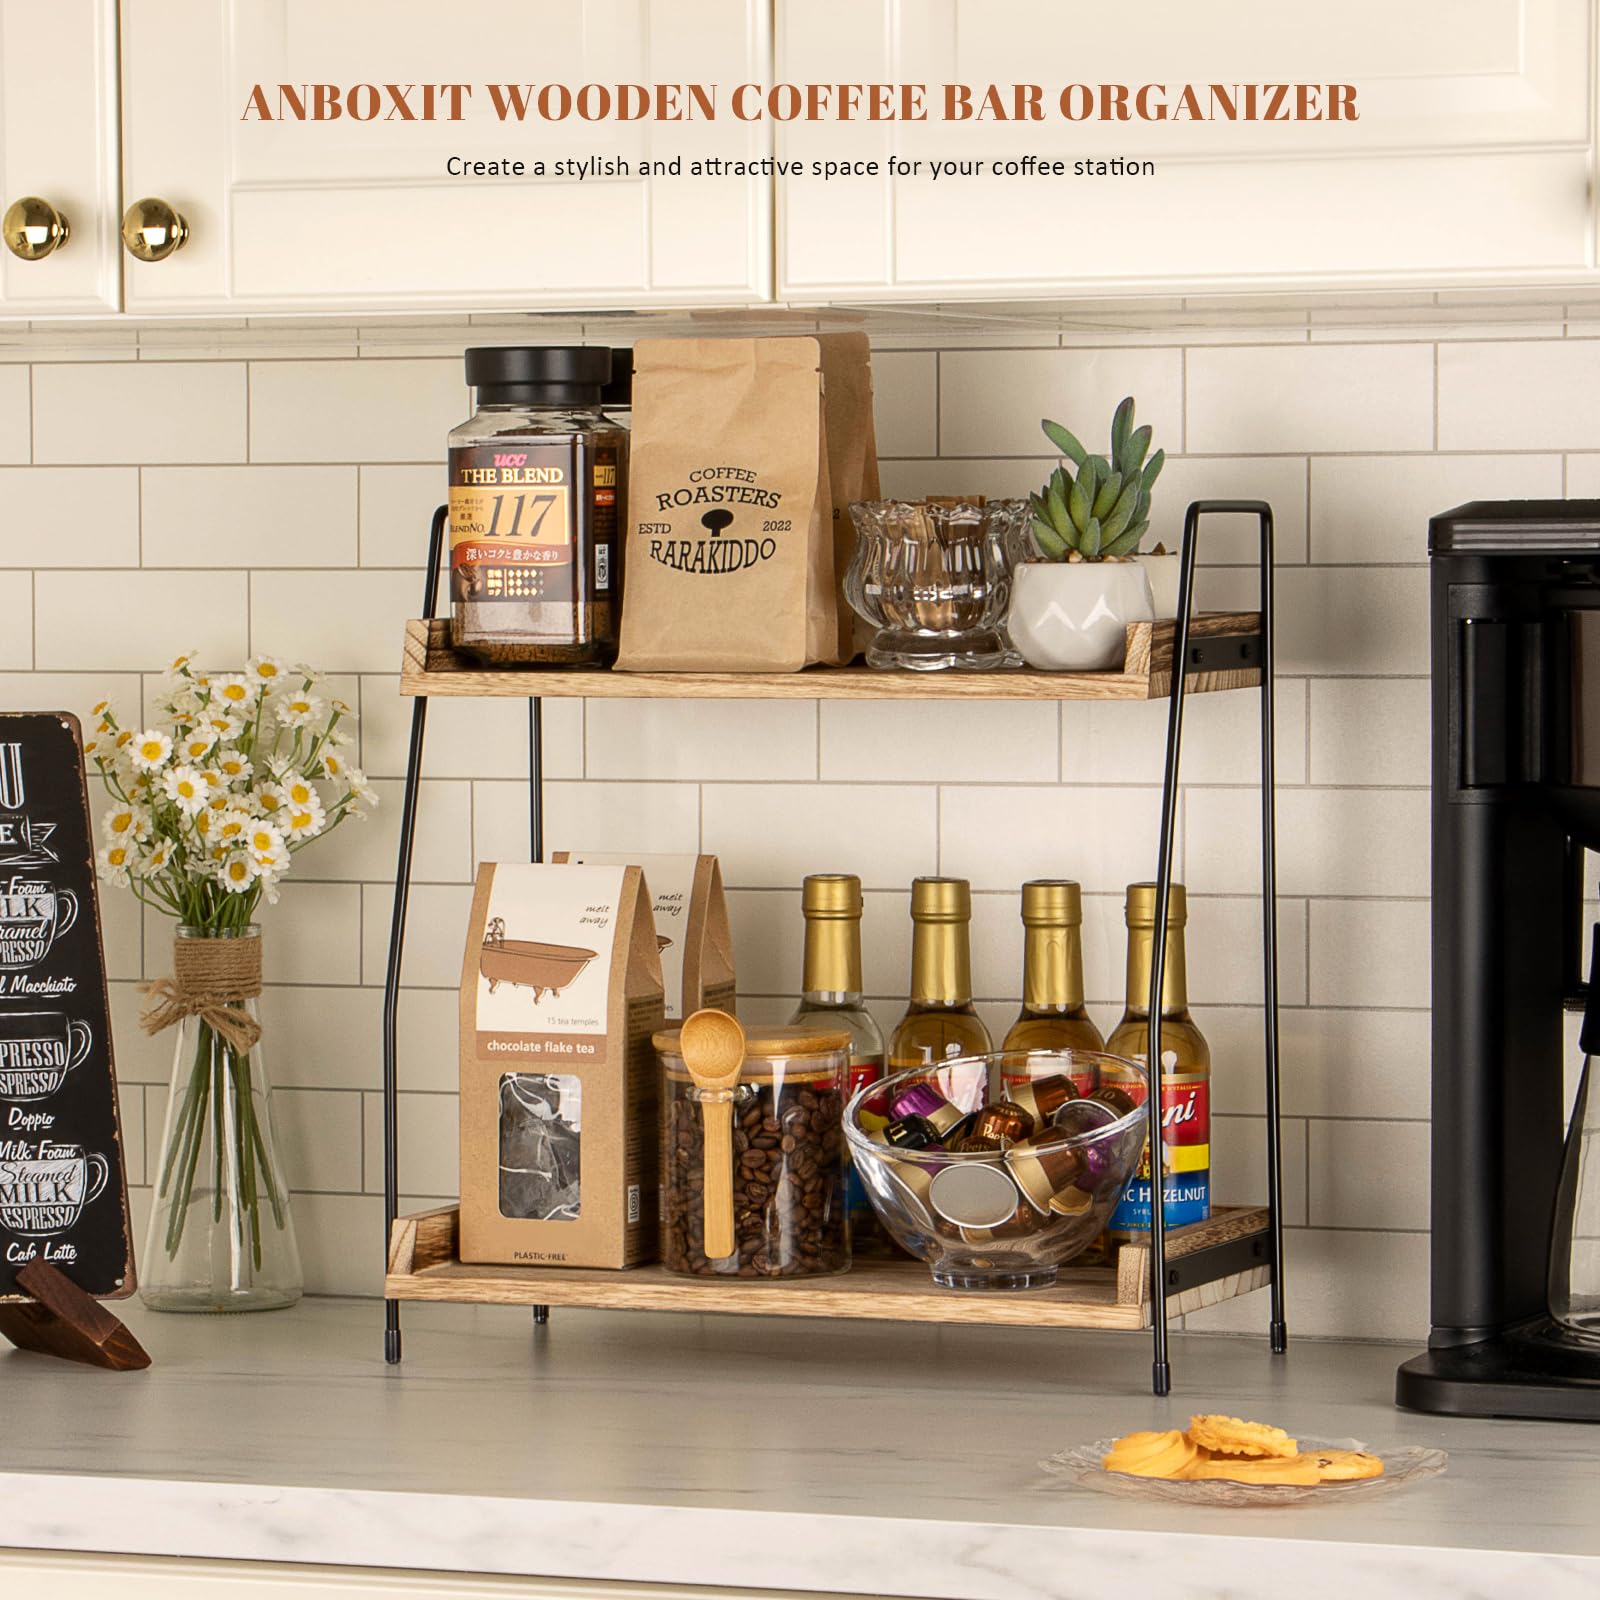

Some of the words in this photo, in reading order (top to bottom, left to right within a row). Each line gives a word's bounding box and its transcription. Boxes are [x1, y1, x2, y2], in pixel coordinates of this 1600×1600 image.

[461, 468, 497, 483] THE
[501, 468, 563, 483] BLEND
[689, 467, 757, 483] COFFEE
[656, 486, 782, 512] ROASTERS
[484, 494, 557, 536] 117
[638, 523, 672, 534] ESTD
[762, 520, 792, 532] 2022
[466, 548, 558, 560] 深いコクと豊かな香り
[650, 538, 776, 574] RARAKIDDO
[9, 876, 47, 895] Foam
[0, 897, 44, 918] LK
[652, 904, 682, 916] away
[579, 917, 608, 928] away
[10, 975, 77, 994] Macchiato
[571, 1018, 599, 1027] temples
[487, 1040, 541, 1053] chocolate
[544, 1042, 573, 1054] flake
[576, 1043, 595, 1054] tea
[8, 1106, 55, 1131] Doppio
[38, 1140, 76, 1160] Foam
[2, 1163, 77, 1184] Steamed
[0, 1182, 75, 1204] MILK
[1139, 1186, 1206, 1203] HZELNUT
[3, 1206, 75, 1230] ESPRESSO
[44, 1242, 78, 1261] Latte
